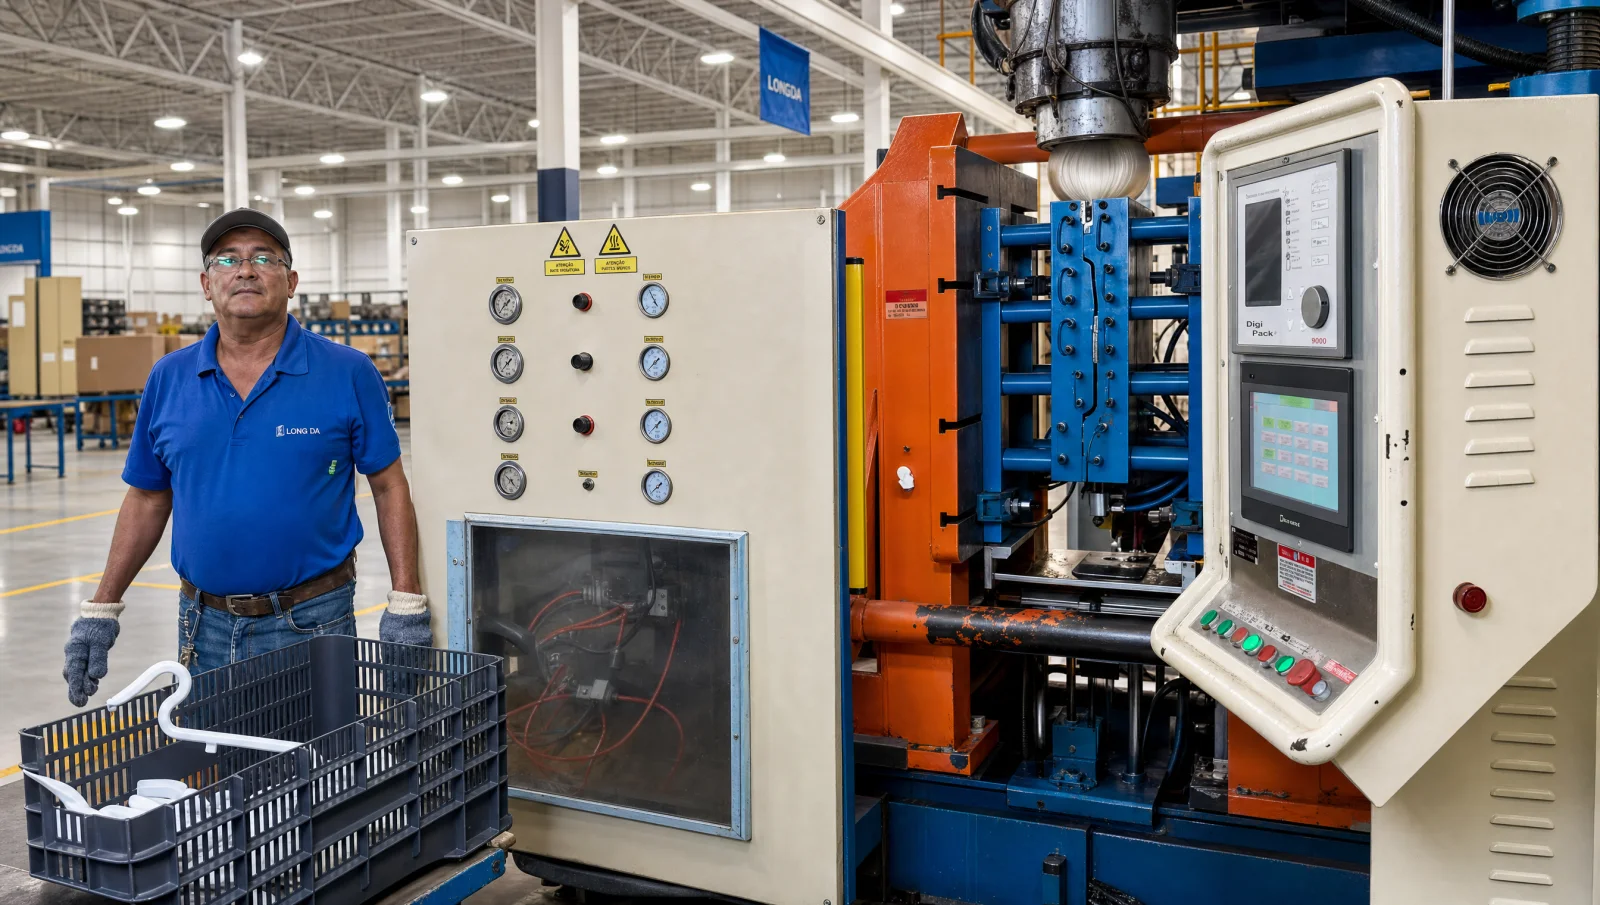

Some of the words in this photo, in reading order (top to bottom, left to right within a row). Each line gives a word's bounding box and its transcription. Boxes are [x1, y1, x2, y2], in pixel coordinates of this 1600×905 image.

[767, 74, 803, 102] LONGDA
[1246, 320, 1263, 329] Digi
[1252, 329, 1274, 337] Pack
[1311, 337, 1327, 345] 9000
[286, 427, 308, 435] LONG
[309, 427, 321, 435] DA
